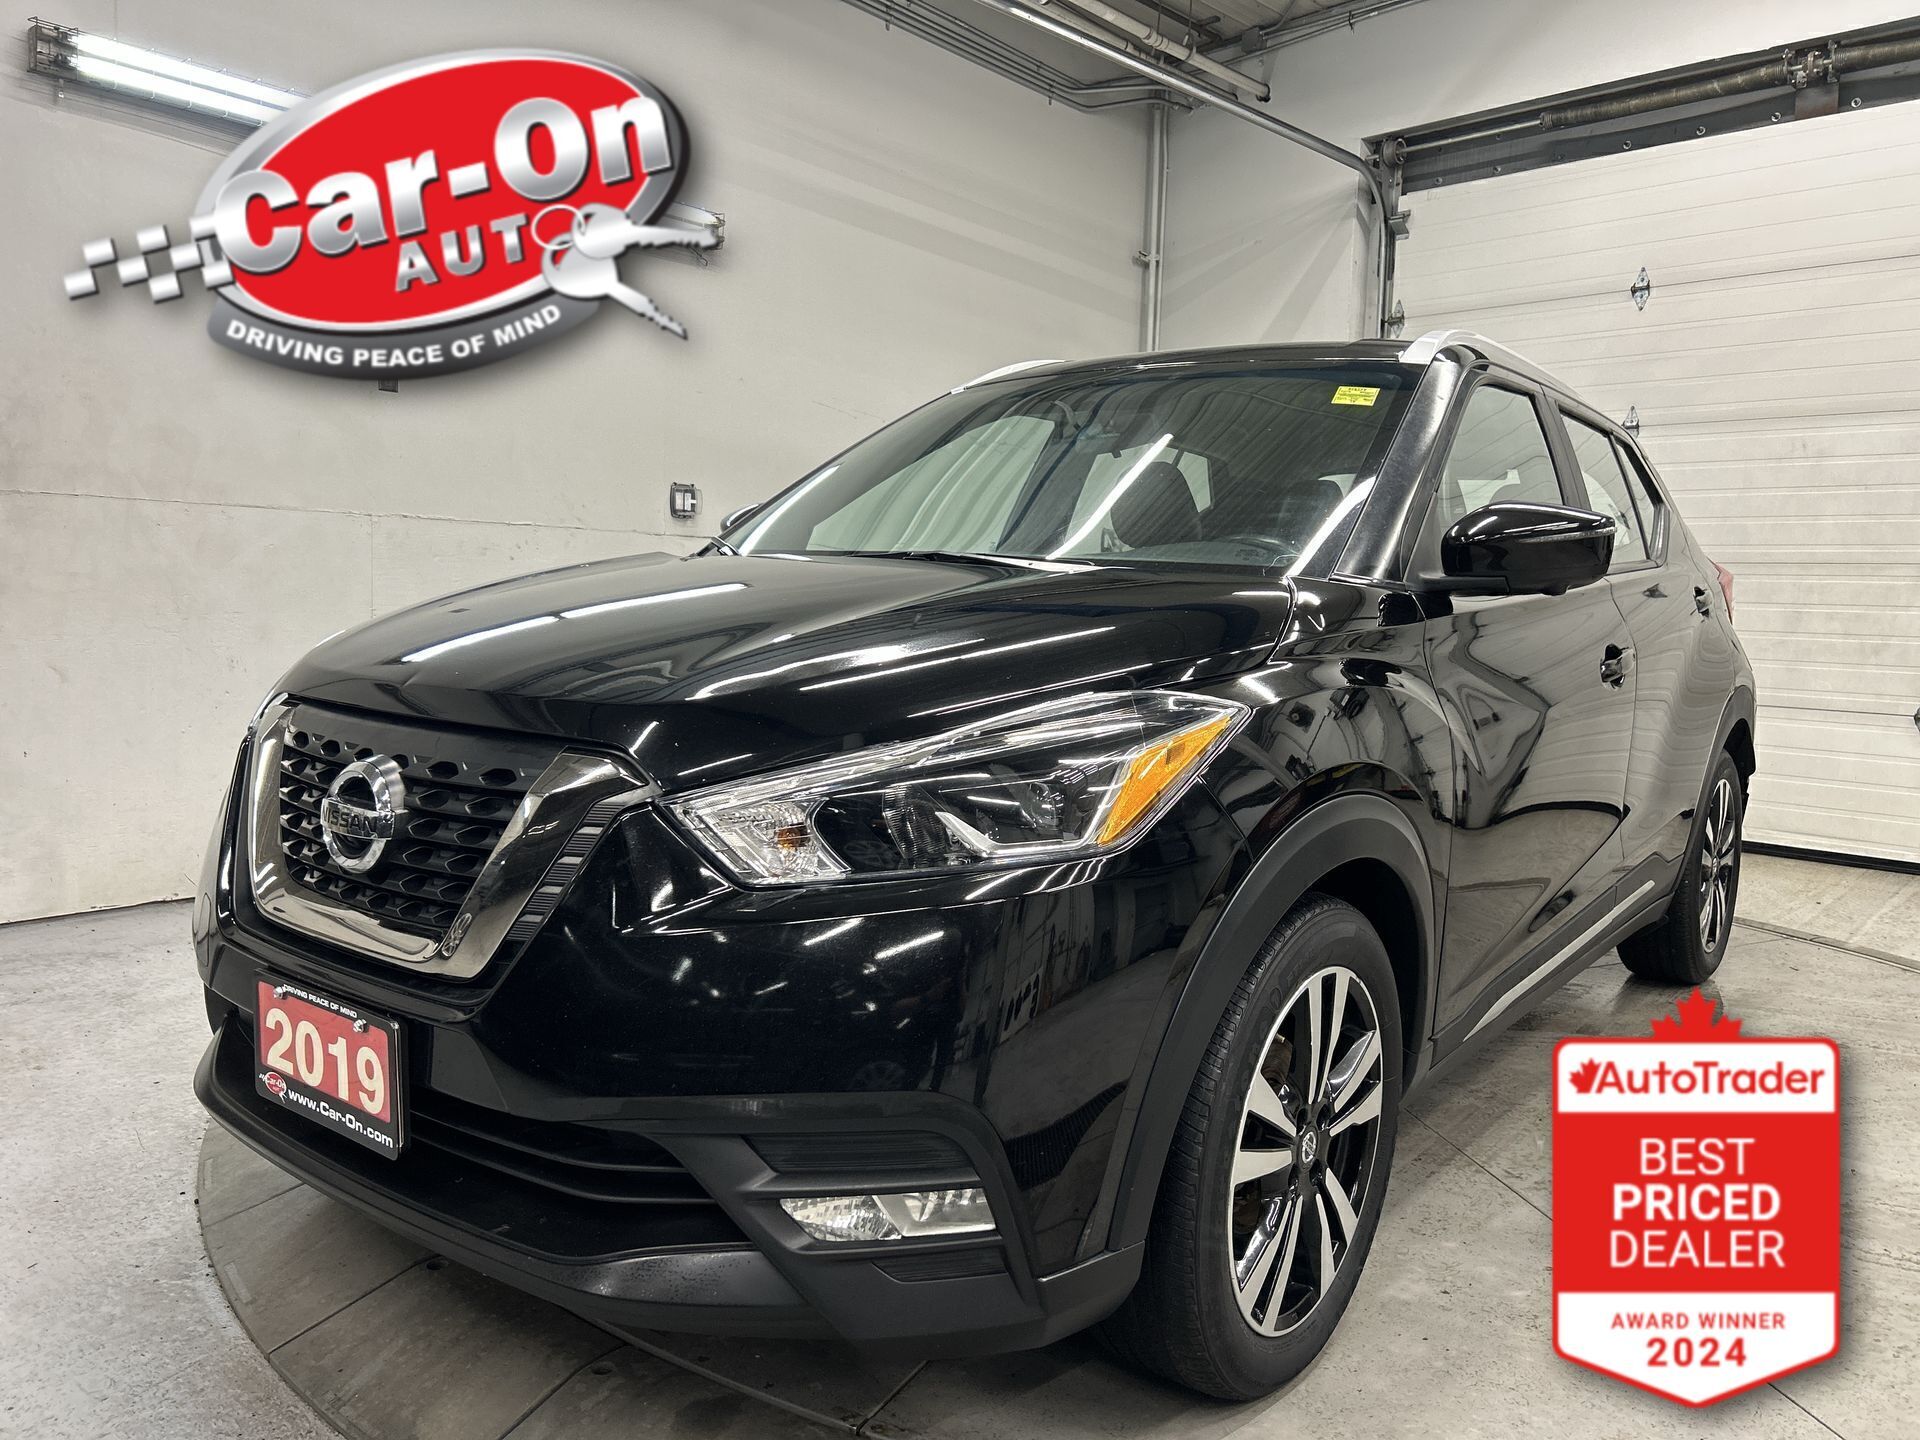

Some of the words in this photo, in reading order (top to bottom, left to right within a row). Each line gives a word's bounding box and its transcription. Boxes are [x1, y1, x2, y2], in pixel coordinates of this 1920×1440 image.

[282, 984, 308, 999] DRIVING
[309, 993, 330, 1008] PEACE
[330, 1002, 340, 1011] OF
[340, 1006, 358, 1018] MIND
[265, 1007, 385, 1115] 2019
[287, 1089, 394, 1149] www.Car-On.com
